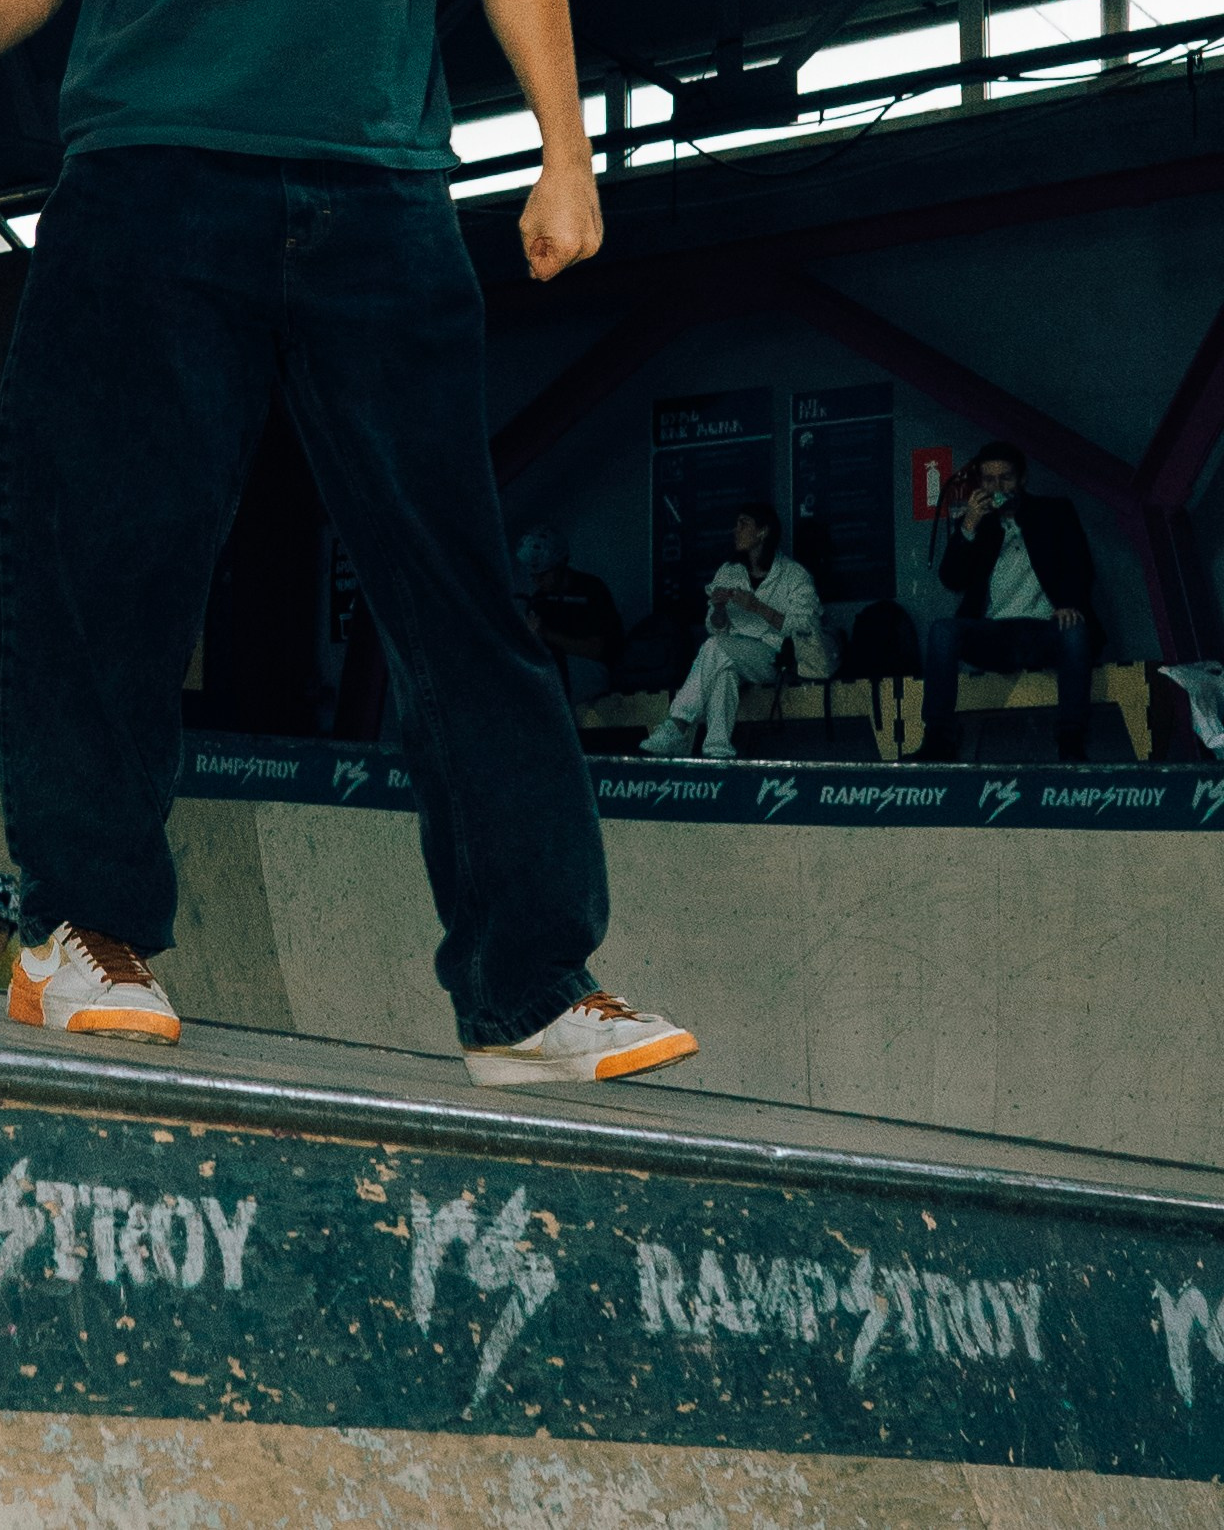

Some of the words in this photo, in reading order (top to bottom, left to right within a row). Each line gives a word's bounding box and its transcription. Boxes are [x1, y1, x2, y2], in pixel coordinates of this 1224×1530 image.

[196, 754, 300, 785] RAMPSTROY
[598, 779, 724, 806] RAMPSTROY
[819, 785, 948, 813] RAMPSTROY
[1041, 785, 1166, 815] RAMPSTROY
[635, 1241, 1044, 1387] RAMPSTROY
